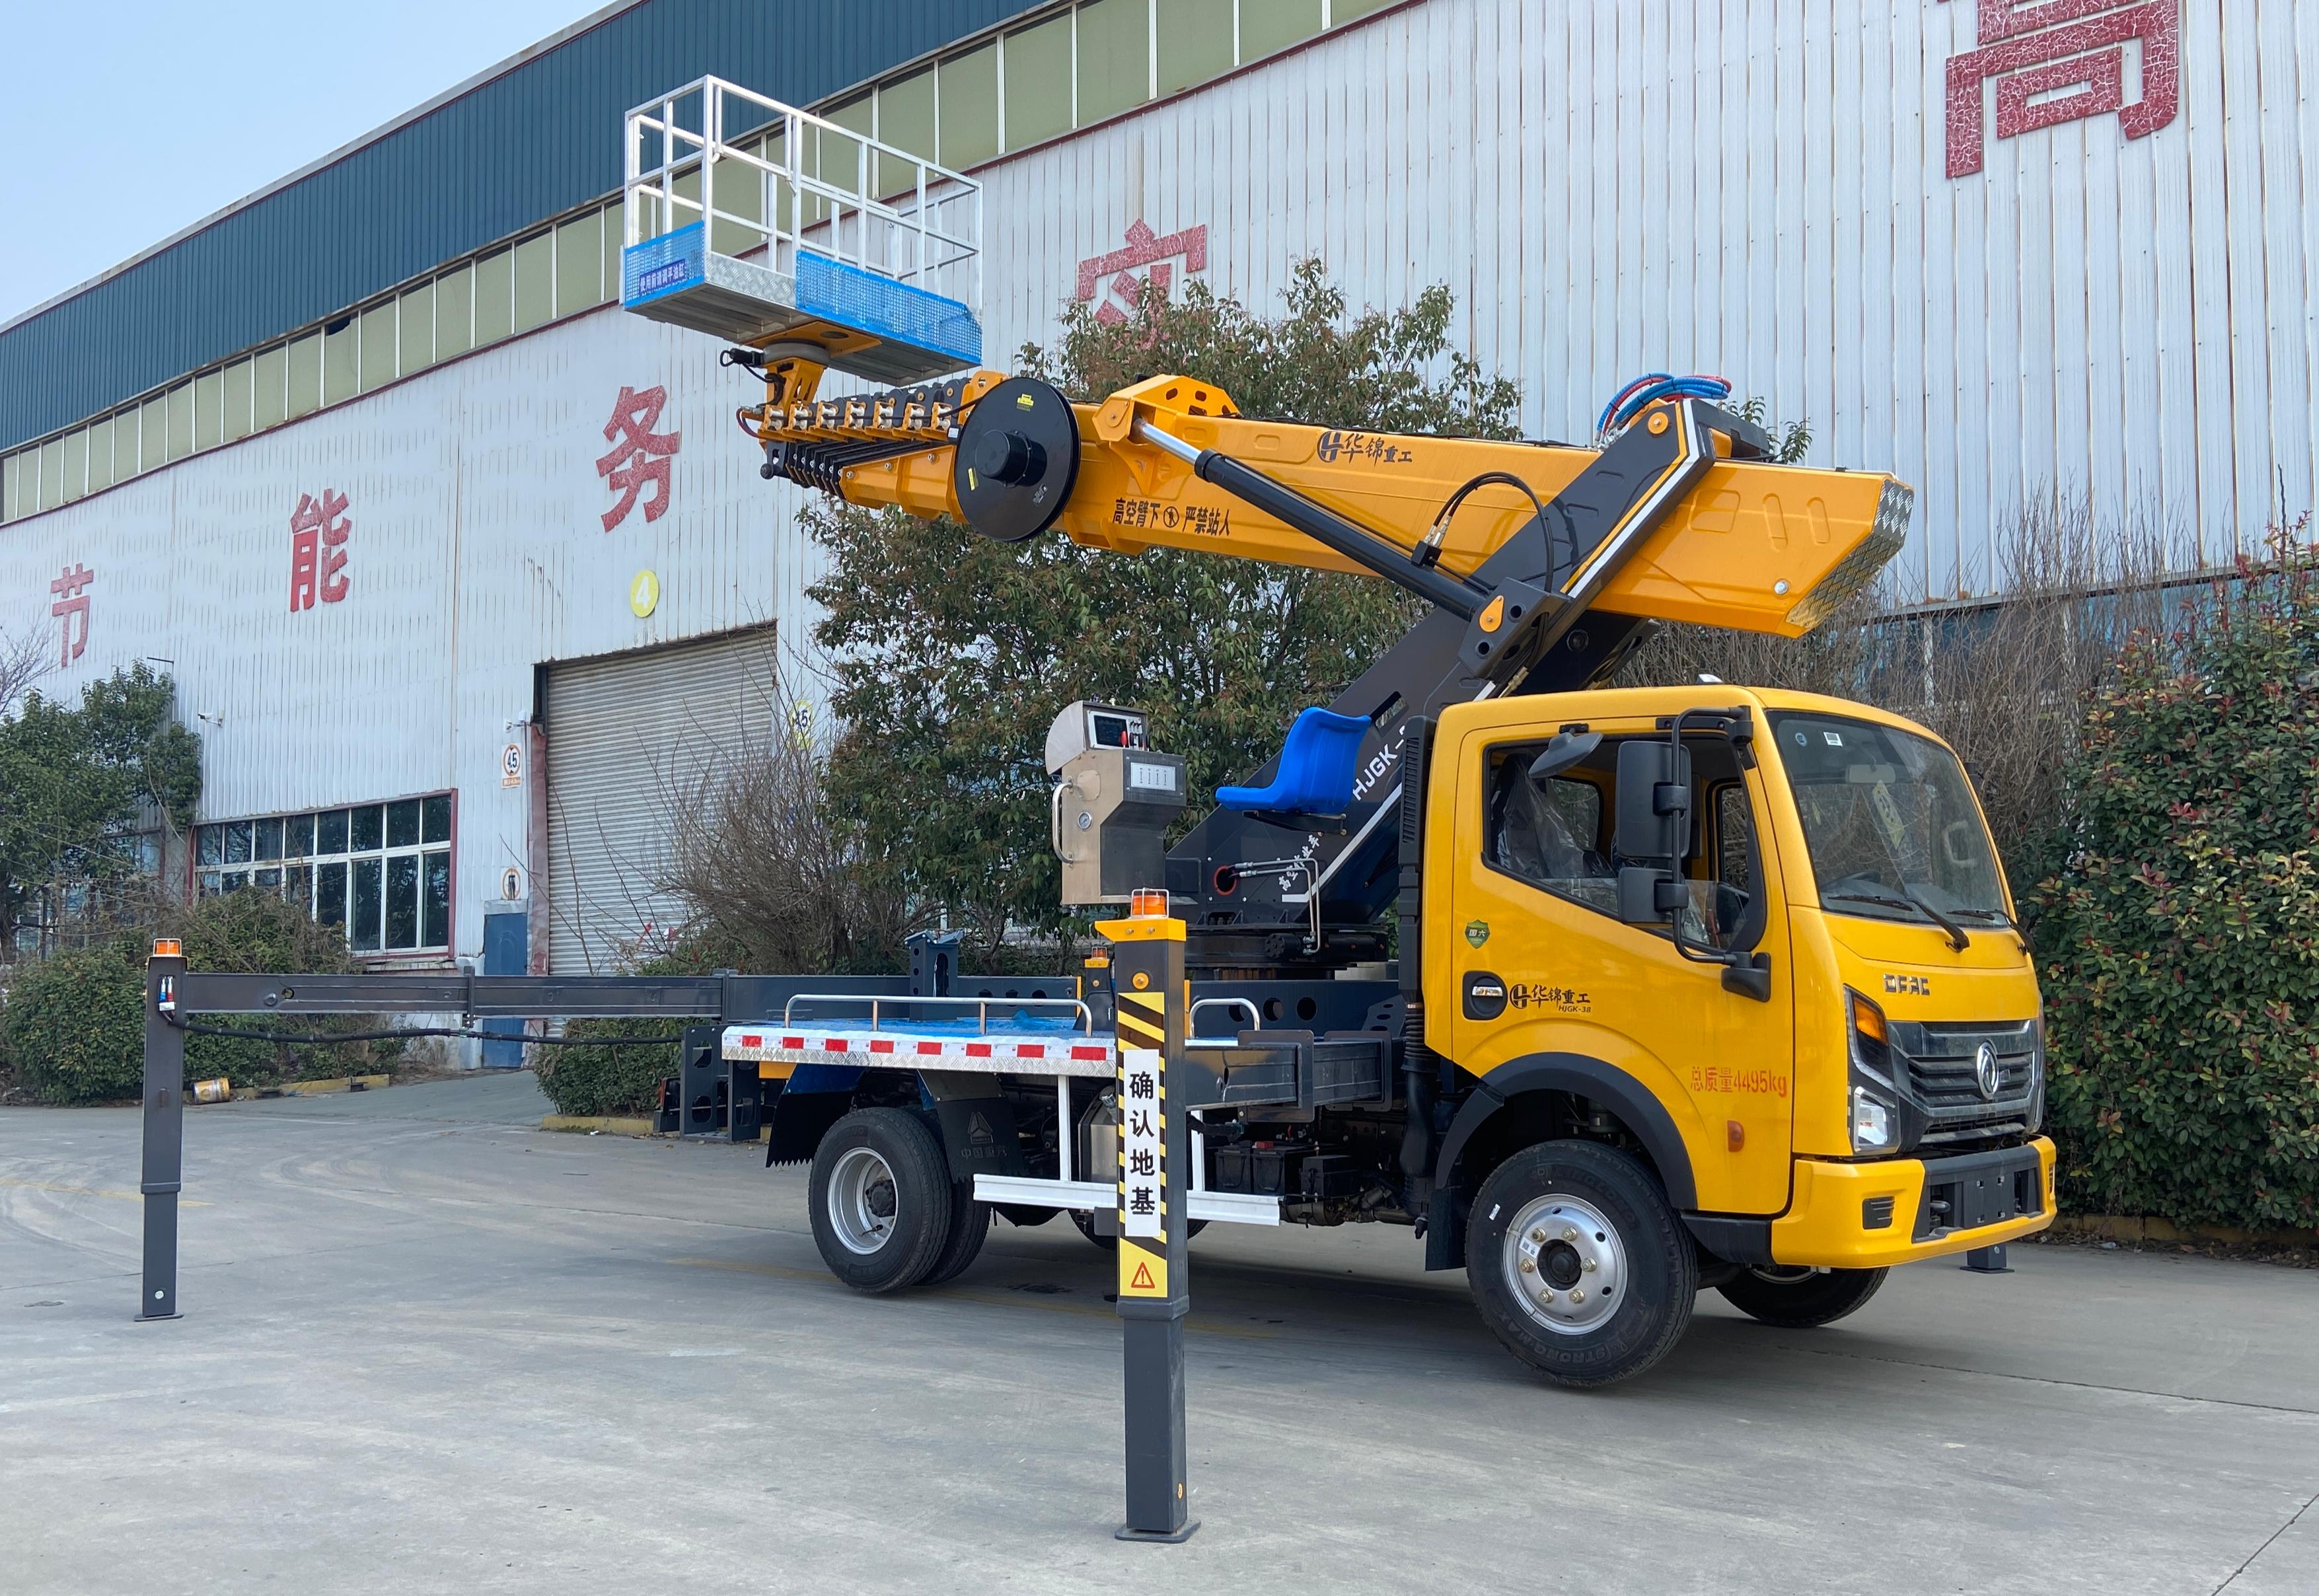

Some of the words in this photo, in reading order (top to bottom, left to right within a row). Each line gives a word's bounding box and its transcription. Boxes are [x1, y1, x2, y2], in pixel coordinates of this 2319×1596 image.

[1341, 433, 1412, 467] 华锦重工
[51, 563, 94, 668] 节
[290, 488, 352, 612] 能
[596, 384, 680, 532] 务
[1112, 497, 1161, 529] 高空臂下
[1182, 506, 1230, 536] 严禁站人
[636, 576, 651, 608] 4
[1469, 929, 1486, 937] 国六
[1530, 984, 1590, 1009] 华锦重工
[1883, 973, 1931, 996] DFAC
[1691, 1066, 1787, 1097] 总质量4495kg
[1129, 1071, 1155, 1215] 确认地基
